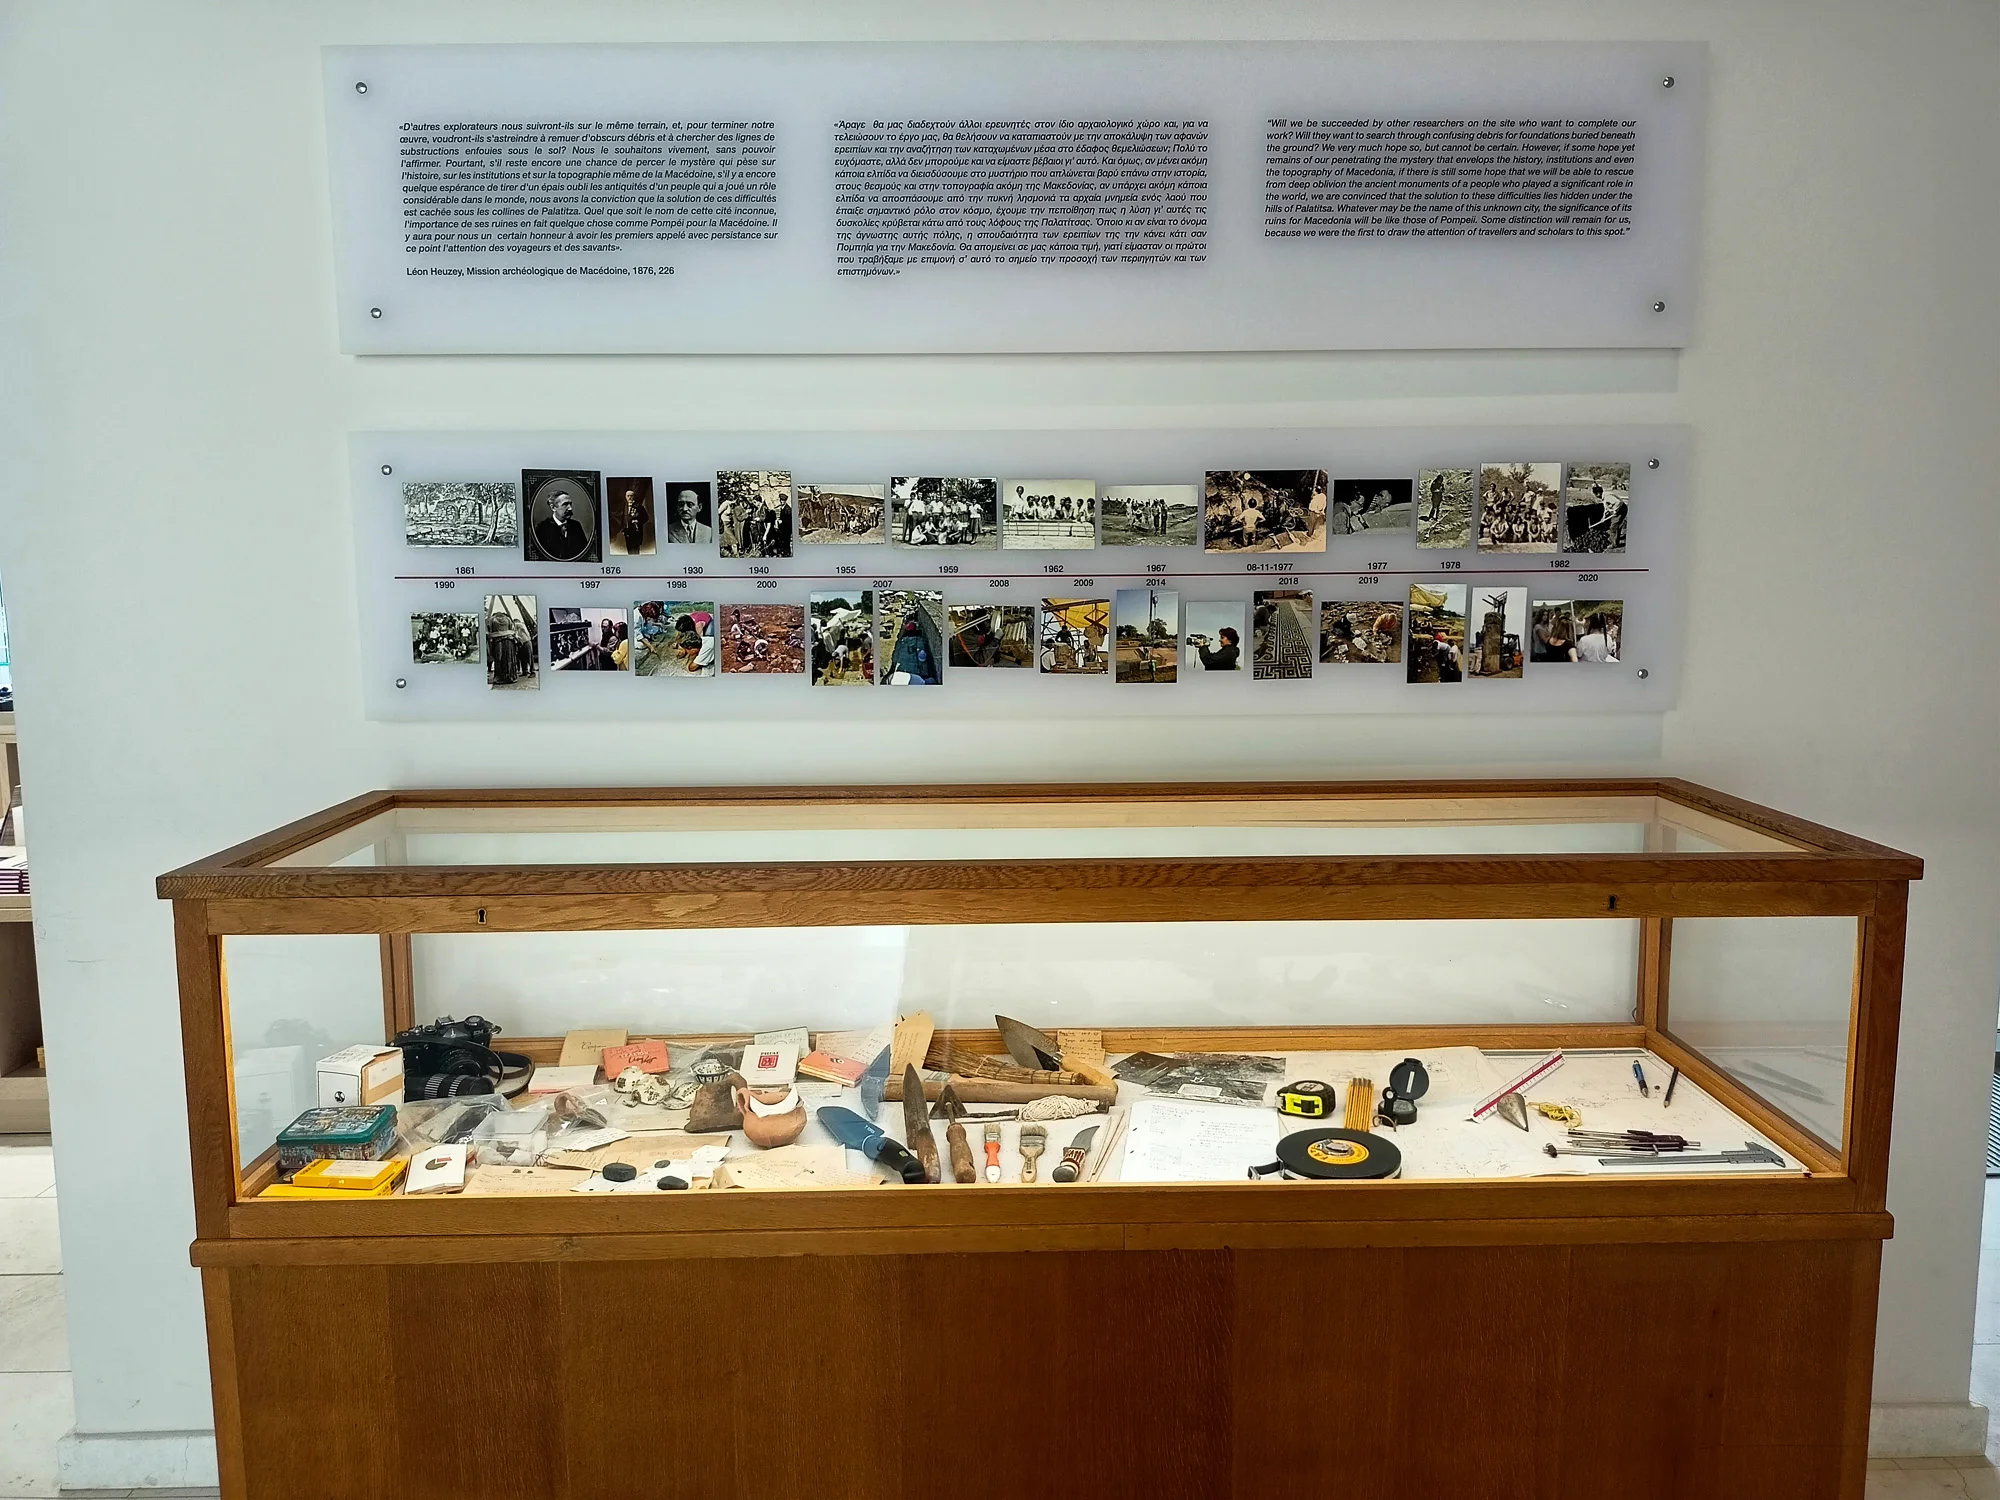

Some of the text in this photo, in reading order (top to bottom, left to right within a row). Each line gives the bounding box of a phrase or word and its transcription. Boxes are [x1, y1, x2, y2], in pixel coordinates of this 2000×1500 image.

[443, 122, 498, 132] explorateurs
[526, 121, 574, 130] suivront-ils
[594, 121, 603, 129] le
[606, 121, 634, 129] même
[637, 121, 668, 130] terrain,
[671, 121, 683, 130] et,
[686, 122, 708, 131] pour
[711, 120, 748, 128] terminer
[751, 120, 774, 128] notre
[872, 120, 884, 128] θα
[886, 121, 903, 131] μας
[906, 120, 956, 130] διαδεχτούν
[958, 120, 982, 128] άλλοι
[984, 119, 1031, 130] ερευνητές
[1058, 119, 1074, 128] ίδιο
[1077, 119, 1133, 130] αρχαιολογικό
[1135, 119, 1160, 130] χώρο
[1163, 120, 1178, 128] και,
[1182, 120, 1194, 130] για
[1306, 118, 1318, 126] be
[1320, 118, 1369, 126] succeeded
[1372, 118, 1383, 129] by
[1386, 118, 1410, 126] other
[1412, 118, 1464, 126] researchers
[1482, 118, 1496, 126] the
[1499, 118, 1515, 126] site
[1518, 118, 1537, 126] who
[1540, 118, 1562, 126] want
[1565, 118, 1574, 126] to
[1577, 118, 1618, 129] complete
[399, 136, 429, 144] œuvre,
[432, 134, 484, 142] voudront-ils
[486, 133, 538, 142] s'astreindre
[540, 133, 545, 142] à
[581, 133, 625, 142] d'obscurs
[627, 133, 655, 141] débris
[657, 133, 666, 141] et
[667, 133, 674, 141] à
[675, 132, 716, 141] chercher
[717, 132, 733, 141] des
[735, 132, 761, 143] lignes
[763, 132, 774, 141] de
[834, 132, 884, 140] τελειώσουν
[898, 132, 919, 143] έργο
[920, 133, 940, 142] μας,
[942, 132, 954, 140] θα
[955, 131, 998, 140] θελήσουν
[1011, 131, 1072, 140] καταπιαστούν
[1072, 133, 1084, 142] με
[1086, 133, 1102, 142] την
[1103, 131, 1153, 142] αποκάλυψη
[1173, 131, 1208, 142] αφανών
[1266, 130, 1635, 141] work? Will they want to search through confusing debris for foundations buried beneath
[1265, 179, 1286, 187] from
[1288, 179, 1310, 190] deep
[1312, 179, 1346, 187] oblivion
[1348, 179, 1362, 187] the
[1364, 179, 1397, 187] ancient
[1398, 179, 1450, 187] monuments
[1451, 178, 1462, 187] of
[1469, 178, 1500, 189] people
[1502, 178, 1520, 187] who
[1521, 178, 1552, 189] played
[1560, 178, 1605, 189] significant
[1606, 178, 1623, 187] role
[1624, 179, 1633, 187] in
[835, 193, 865, 202] ελπίδα
[881, 193, 943, 204] αποσπάσουμε
[946, 193, 966, 202] από
[968, 194, 984, 204] την
[986, 193, 1013, 201] πυκνή
[1016, 192, 1056, 203] λησμονιά
[1072, 192, 1101, 203] αρχαία
[1104, 192, 1138, 203] μνημεία
[1140, 192, 1162, 203] ενός
[1164, 192, 1186, 200] λαού
[418, 244, 441, 254] point
[442, 243, 486, 252] l'attention
[488, 243, 504, 252] des
[506, 244, 551, 254] voyageurs
[553, 243, 562, 251] et
[564, 243, 580, 251] des
[406, 266, 674, 278] Léon Heuzey, Mission archéologique de Macédoine, 1876, 226
[1044, 564, 1064, 573] 1962
[1146, 564, 1166, 573] 1967
[1246, 562, 1294, 572] 08-11-1977
[1368, 562, 1388, 570] 1977
[1440, 562, 1460, 570] 1978
[1550, 560, 1570, 568] 1982
[456, 566, 474, 575] 1861
[600, 566, 622, 575] 1876
[682, 566, 704, 575] 1930
[748, 566, 770, 575] 1940
[836, 566, 856, 574] 1955
[938, 566, 958, 574] 1959
[1074, 578, 1094, 587] 2009
[1146, 578, 1166, 587] 2014
[1278, 576, 1298, 586] 2018
[1358, 576, 1378, 585] 2019
[1578, 574, 1598, 582] 2020
[434, 580, 454, 589] 1990
[580, 580, 600, 589] 1997
[666, 580, 688, 589] 1998
[756, 580, 778, 589] 2000
[872, 580, 893, 588] 2007
[990, 580, 1010, 588] 2008
